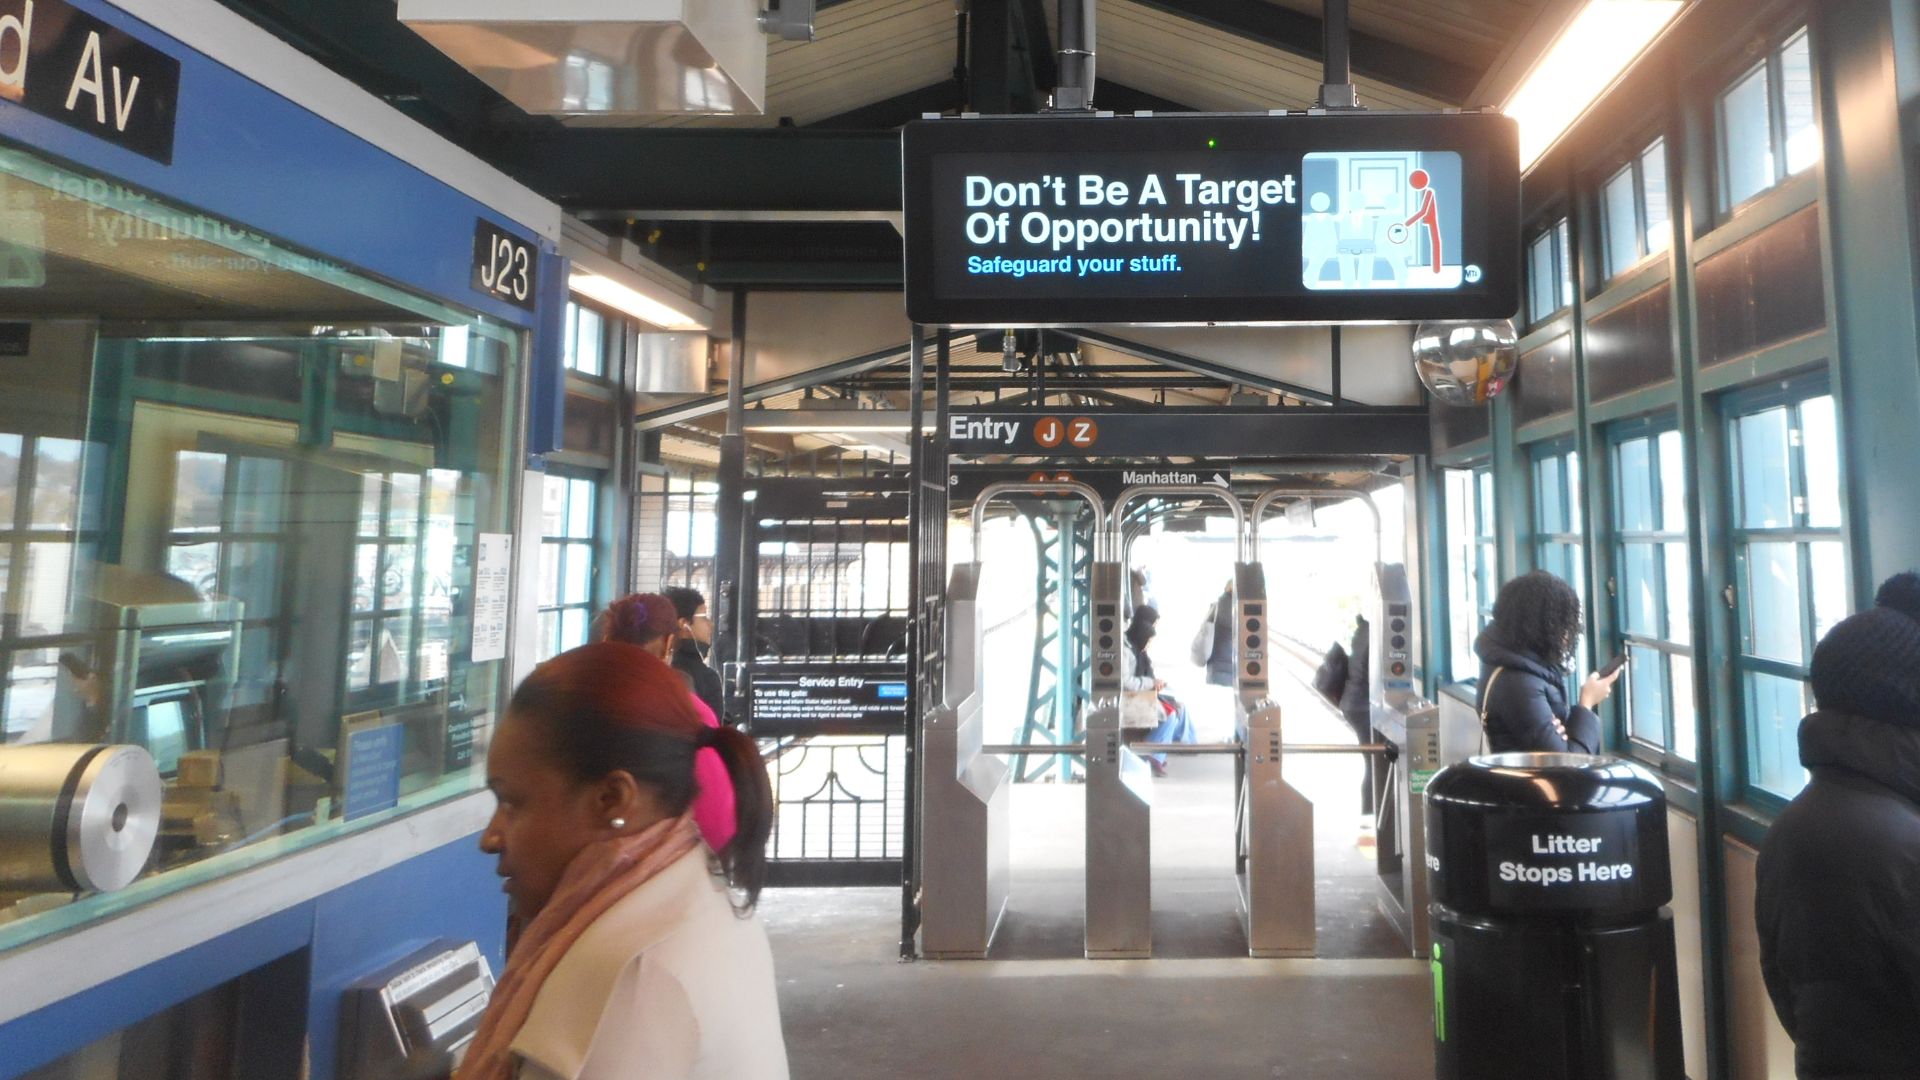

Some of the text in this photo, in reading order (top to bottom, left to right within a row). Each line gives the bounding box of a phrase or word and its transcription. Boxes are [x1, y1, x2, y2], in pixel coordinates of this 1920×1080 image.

[65, 30, 140, 132] Av
[965, 173, 1296, 212] Don’t Be A Target
[965, 210, 1261, 251] Of Opportunity!
[481, 233, 528, 301] J23
[967, 253, 1182, 277] Safeguard your stuff.
[950, 416, 1090, 444] Entry J Z
[1123, 471, 1197, 485] Manhattan
[1389, 651, 1407, 661] Entry
[754, 689, 762, 697] To
[777, 689, 790, 697] this
[799, 676, 864, 688] Service Entry
[1531, 834, 1602, 854] Litter
[1499, 861, 1633, 886] Stops Here
